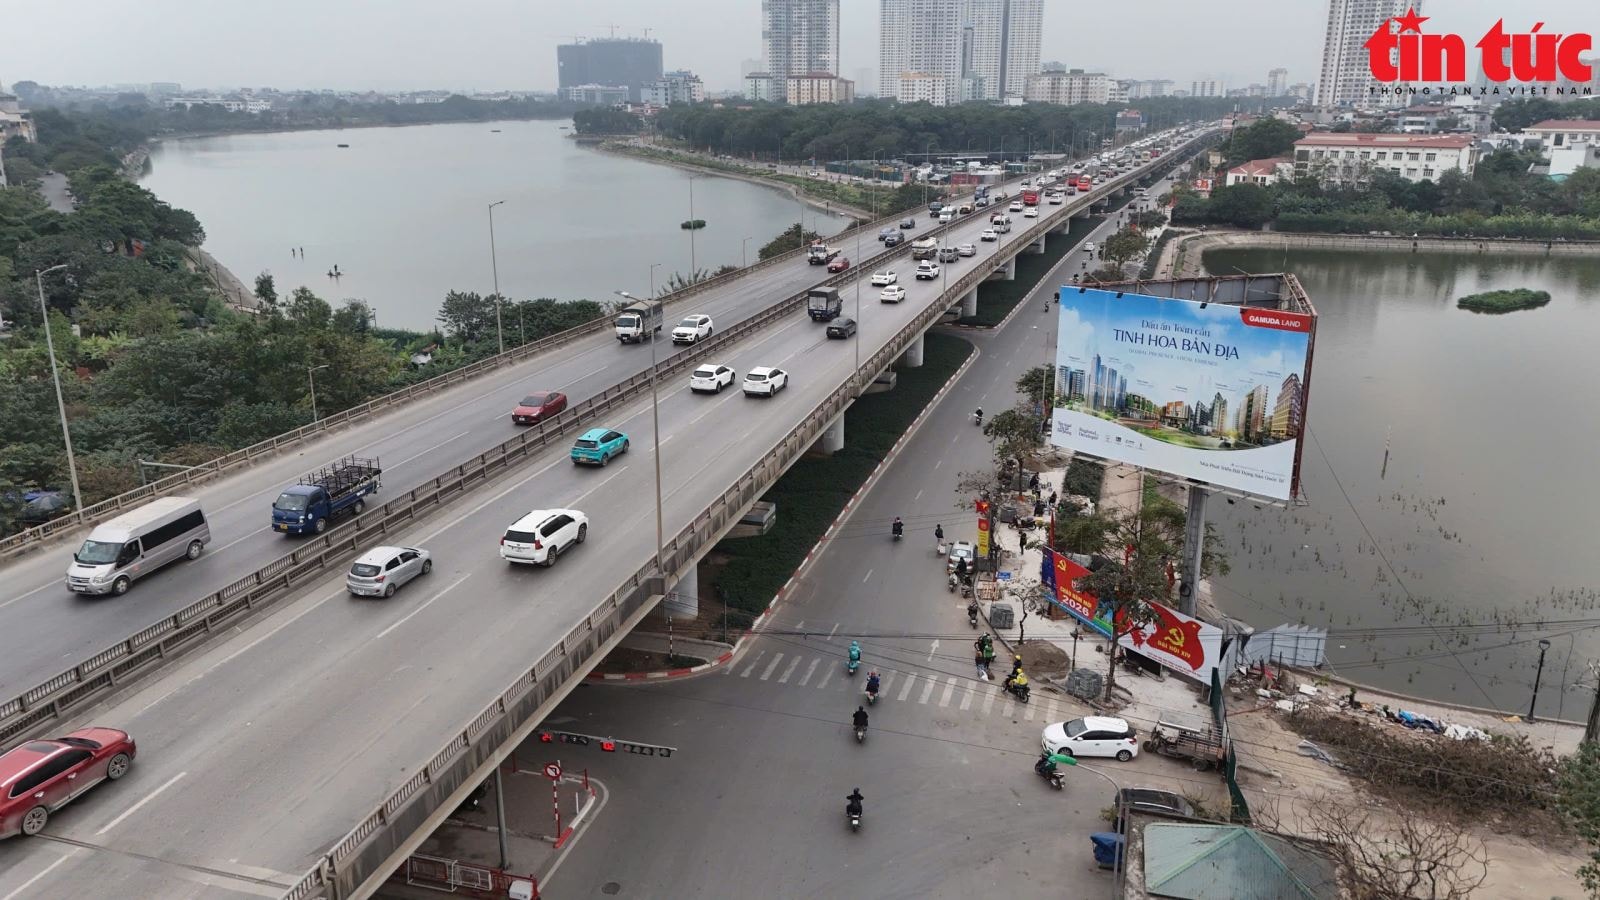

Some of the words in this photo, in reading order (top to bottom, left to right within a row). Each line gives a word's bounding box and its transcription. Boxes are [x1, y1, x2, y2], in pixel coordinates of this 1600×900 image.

[1249, 315, 1280, 325] GAMUDA
[1281, 320, 1301, 328] LAND
[1113, 328, 1144, 345] TINH
[1148, 333, 1178, 350] HOA
[1181, 336, 1211, 355] BẢN
[1215, 343, 1240, 361] ĐỊA
[1062, 594, 1090, 617] 2026
